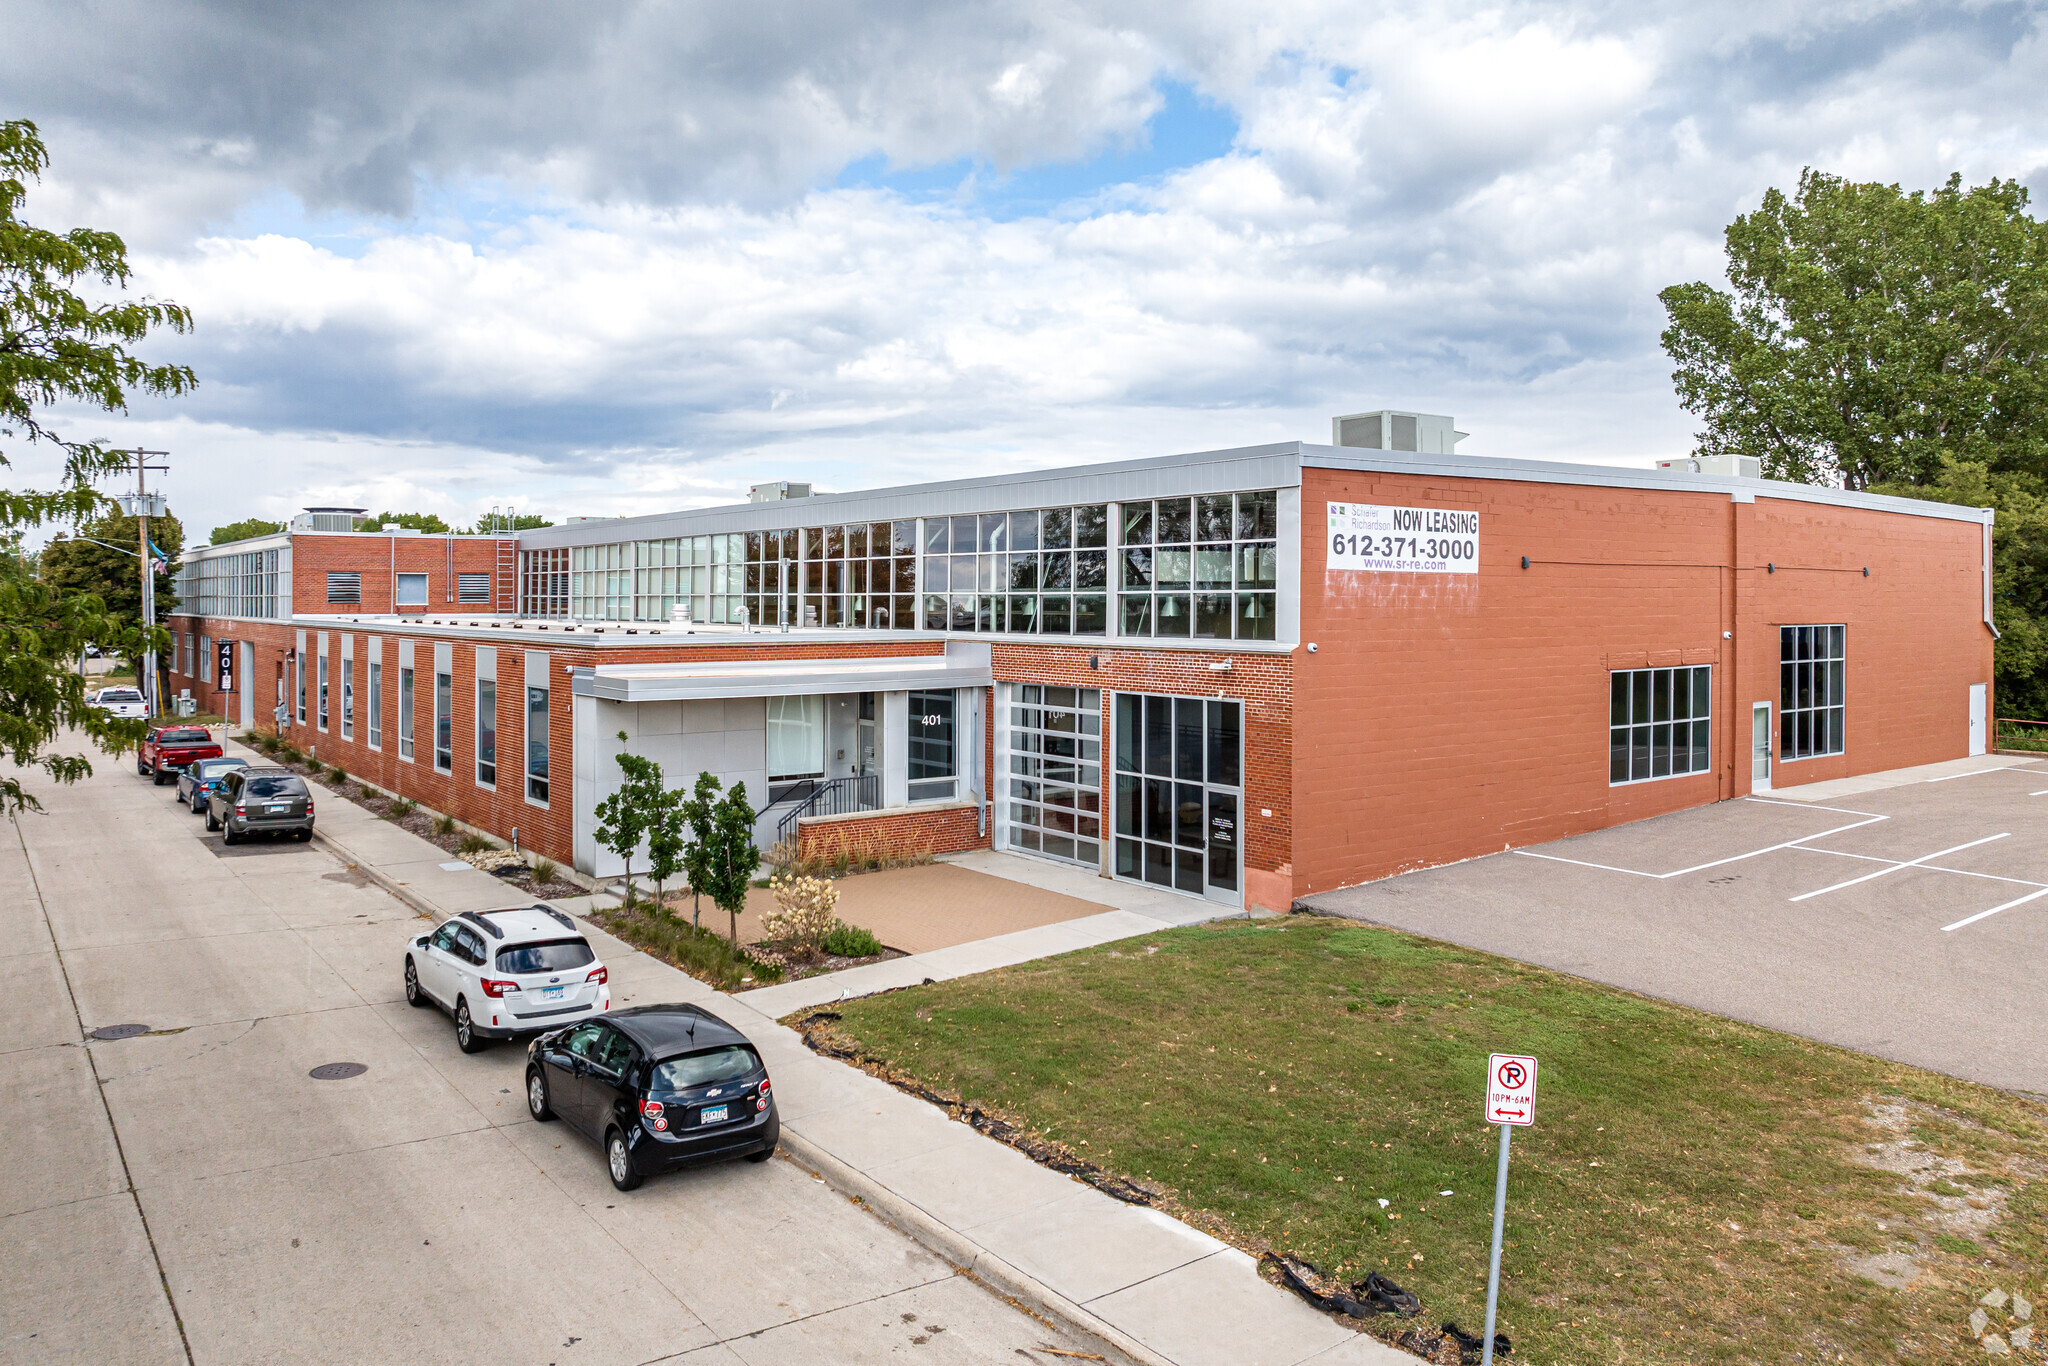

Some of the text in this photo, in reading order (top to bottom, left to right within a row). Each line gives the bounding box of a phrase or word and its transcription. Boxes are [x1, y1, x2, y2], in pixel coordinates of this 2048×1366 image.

[1351, 518, 1391, 531] Richardson
[1393, 509, 1477, 534] NOW LEASING
[1332, 533, 1474, 560] 612-371-3000
[1364, 558, 1446, 570] www.sr-re.com
[921, 714, 941, 726] 401
[1492, 1093, 1530, 1104] 10PM-6AM
